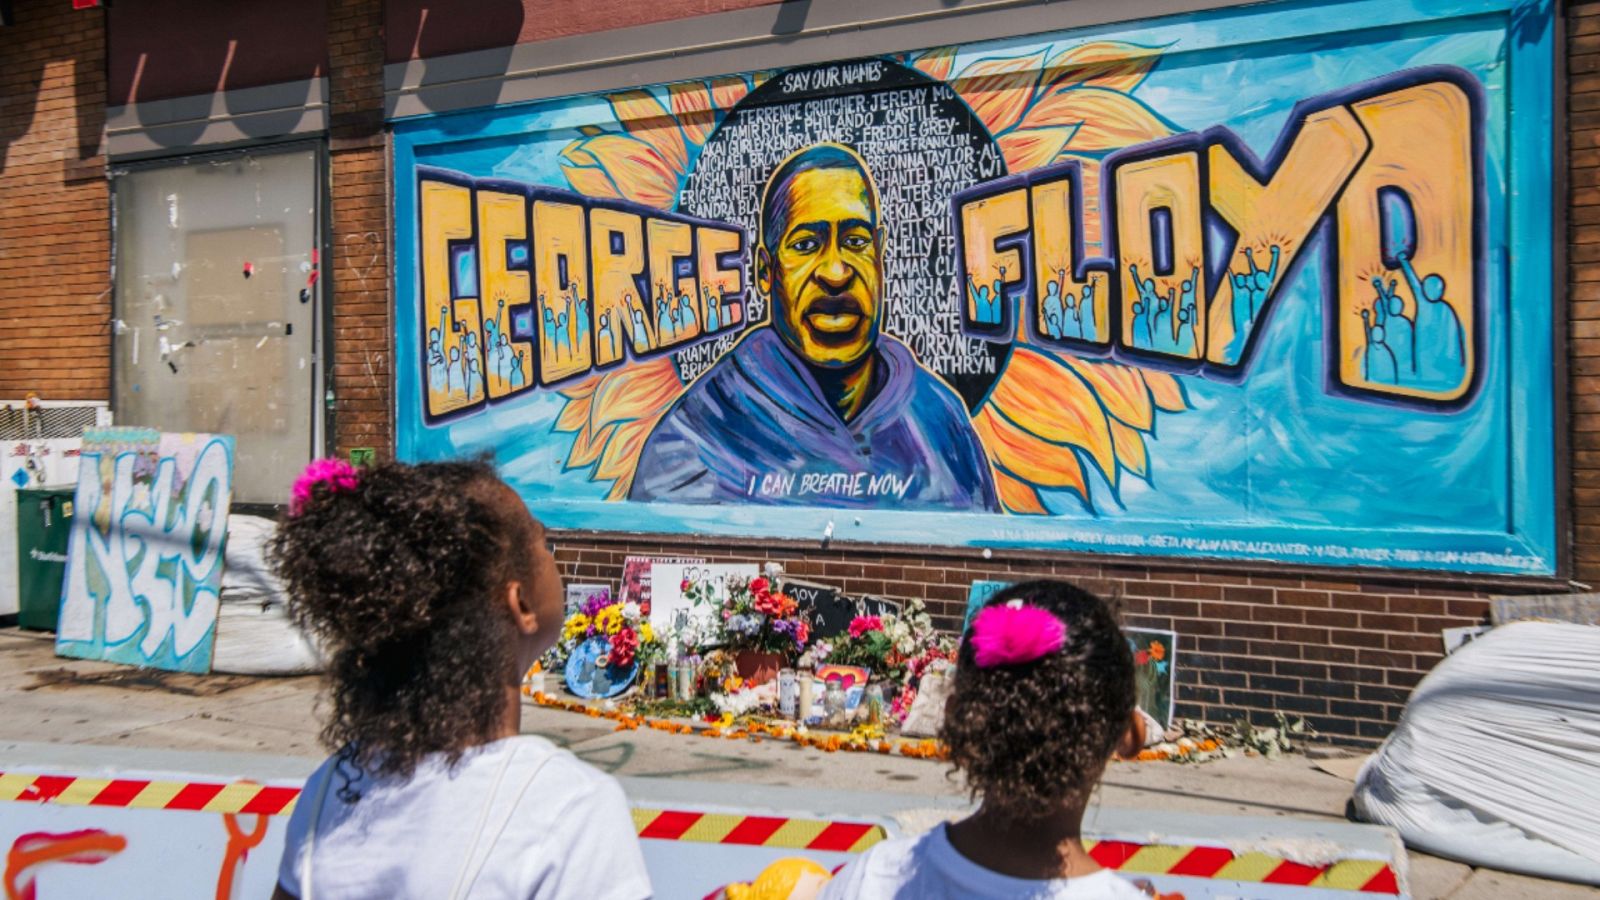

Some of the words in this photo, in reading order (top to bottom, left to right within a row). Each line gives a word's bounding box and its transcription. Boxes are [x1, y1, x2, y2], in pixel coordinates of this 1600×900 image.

[783, 73, 811, 93] SAY
[812, 67, 841, 88] OUR
[842, 61, 882, 84] NAMES
[737, 103, 802, 125] TERRENCE
[805, 94, 867, 118] CRUTCHER
[869, 88, 928, 112] JEREMY
[722, 123, 760, 141] TAMIR
[762, 120, 793, 139] RICE
[805, 113, 874, 133] PHILANDO
[886, 103, 939, 125] CASTILE
[702, 140, 726, 158] AKAI
[766, 133, 811, 151] KENDRA
[812, 127, 853, 144] JAMES
[863, 123, 917, 140] FREDDIE
[919, 117, 955, 136] GREY
[854, 139, 909, 157] TERRANCE
[911, 133, 970, 150] FRANKLIN
[696, 154, 746, 173] MICHAEL
[866, 152, 926, 171] BREONNA
[925, 147, 975, 166] TAYLOR
[688, 169, 730, 190] TYISHA
[873, 165, 932, 188] SHANTEL
[934, 162, 974, 182] DAVIS
[680, 188, 706, 206] ERIC
[708, 184, 757, 203] GARNER
[880, 184, 932, 204] WALTER
[688, 201, 735, 219] SANDRA
[880, 201, 919, 221] REKIA
[924, 216, 951, 238] SMI
[417, 168, 748, 424] GEORGE
[955, 70, 1482, 408] FLOYD
[885, 237, 933, 258] SHELLY
[884, 256, 932, 280] JAMAR
[884, 277, 945, 298] TANISHA
[884, 297, 936, 316] TARIKA
[885, 314, 930, 335] ALTON
[922, 355, 996, 374] KATHRYN
[747, 474, 756, 496] I
[761, 472, 796, 496] CAN
[798, 472, 869, 496] BREATHE
[868, 473, 915, 499] NOW
